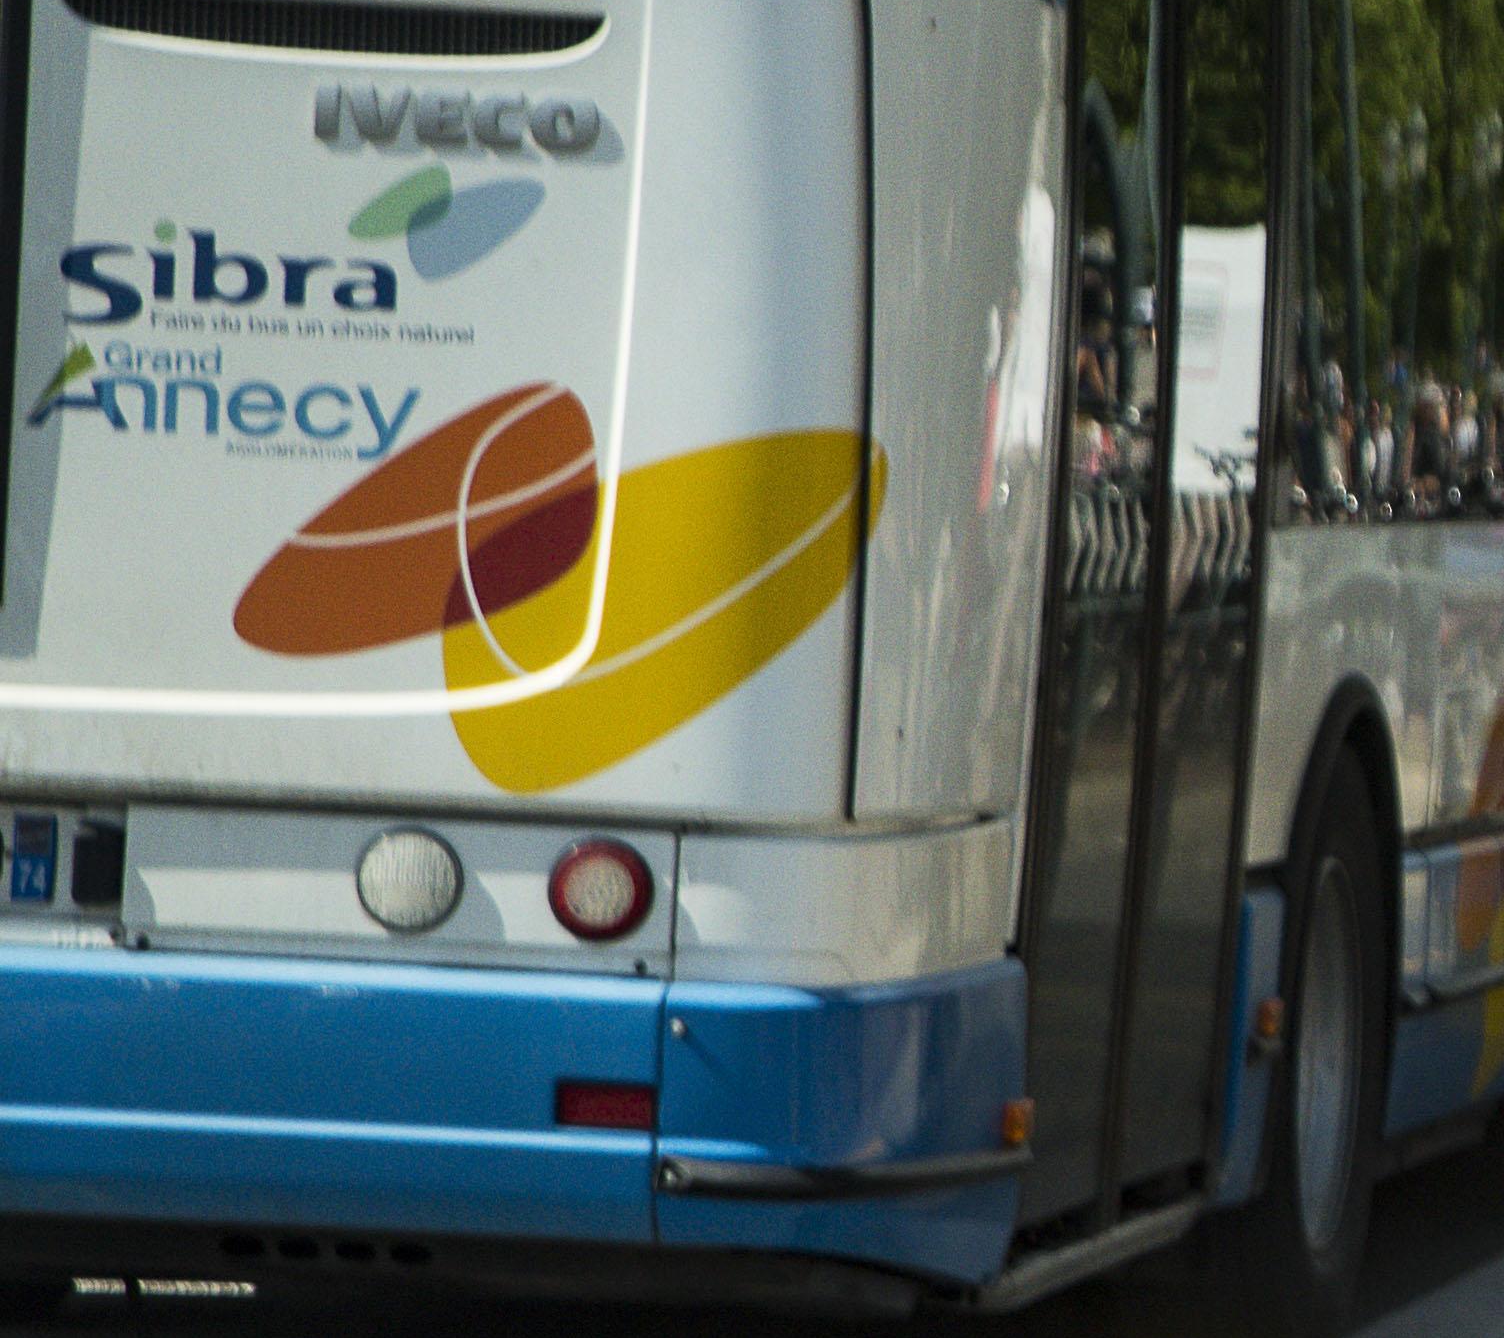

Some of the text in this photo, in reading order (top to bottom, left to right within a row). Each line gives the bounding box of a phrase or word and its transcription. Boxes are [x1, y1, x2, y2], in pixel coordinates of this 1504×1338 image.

[313, 83, 602, 155] IVECO
[60, 217, 399, 325] Sibra
[104, 341, 223, 375] Grand
[27, 346, 421, 460] Annecy
[19, 858, 47, 895] 74
